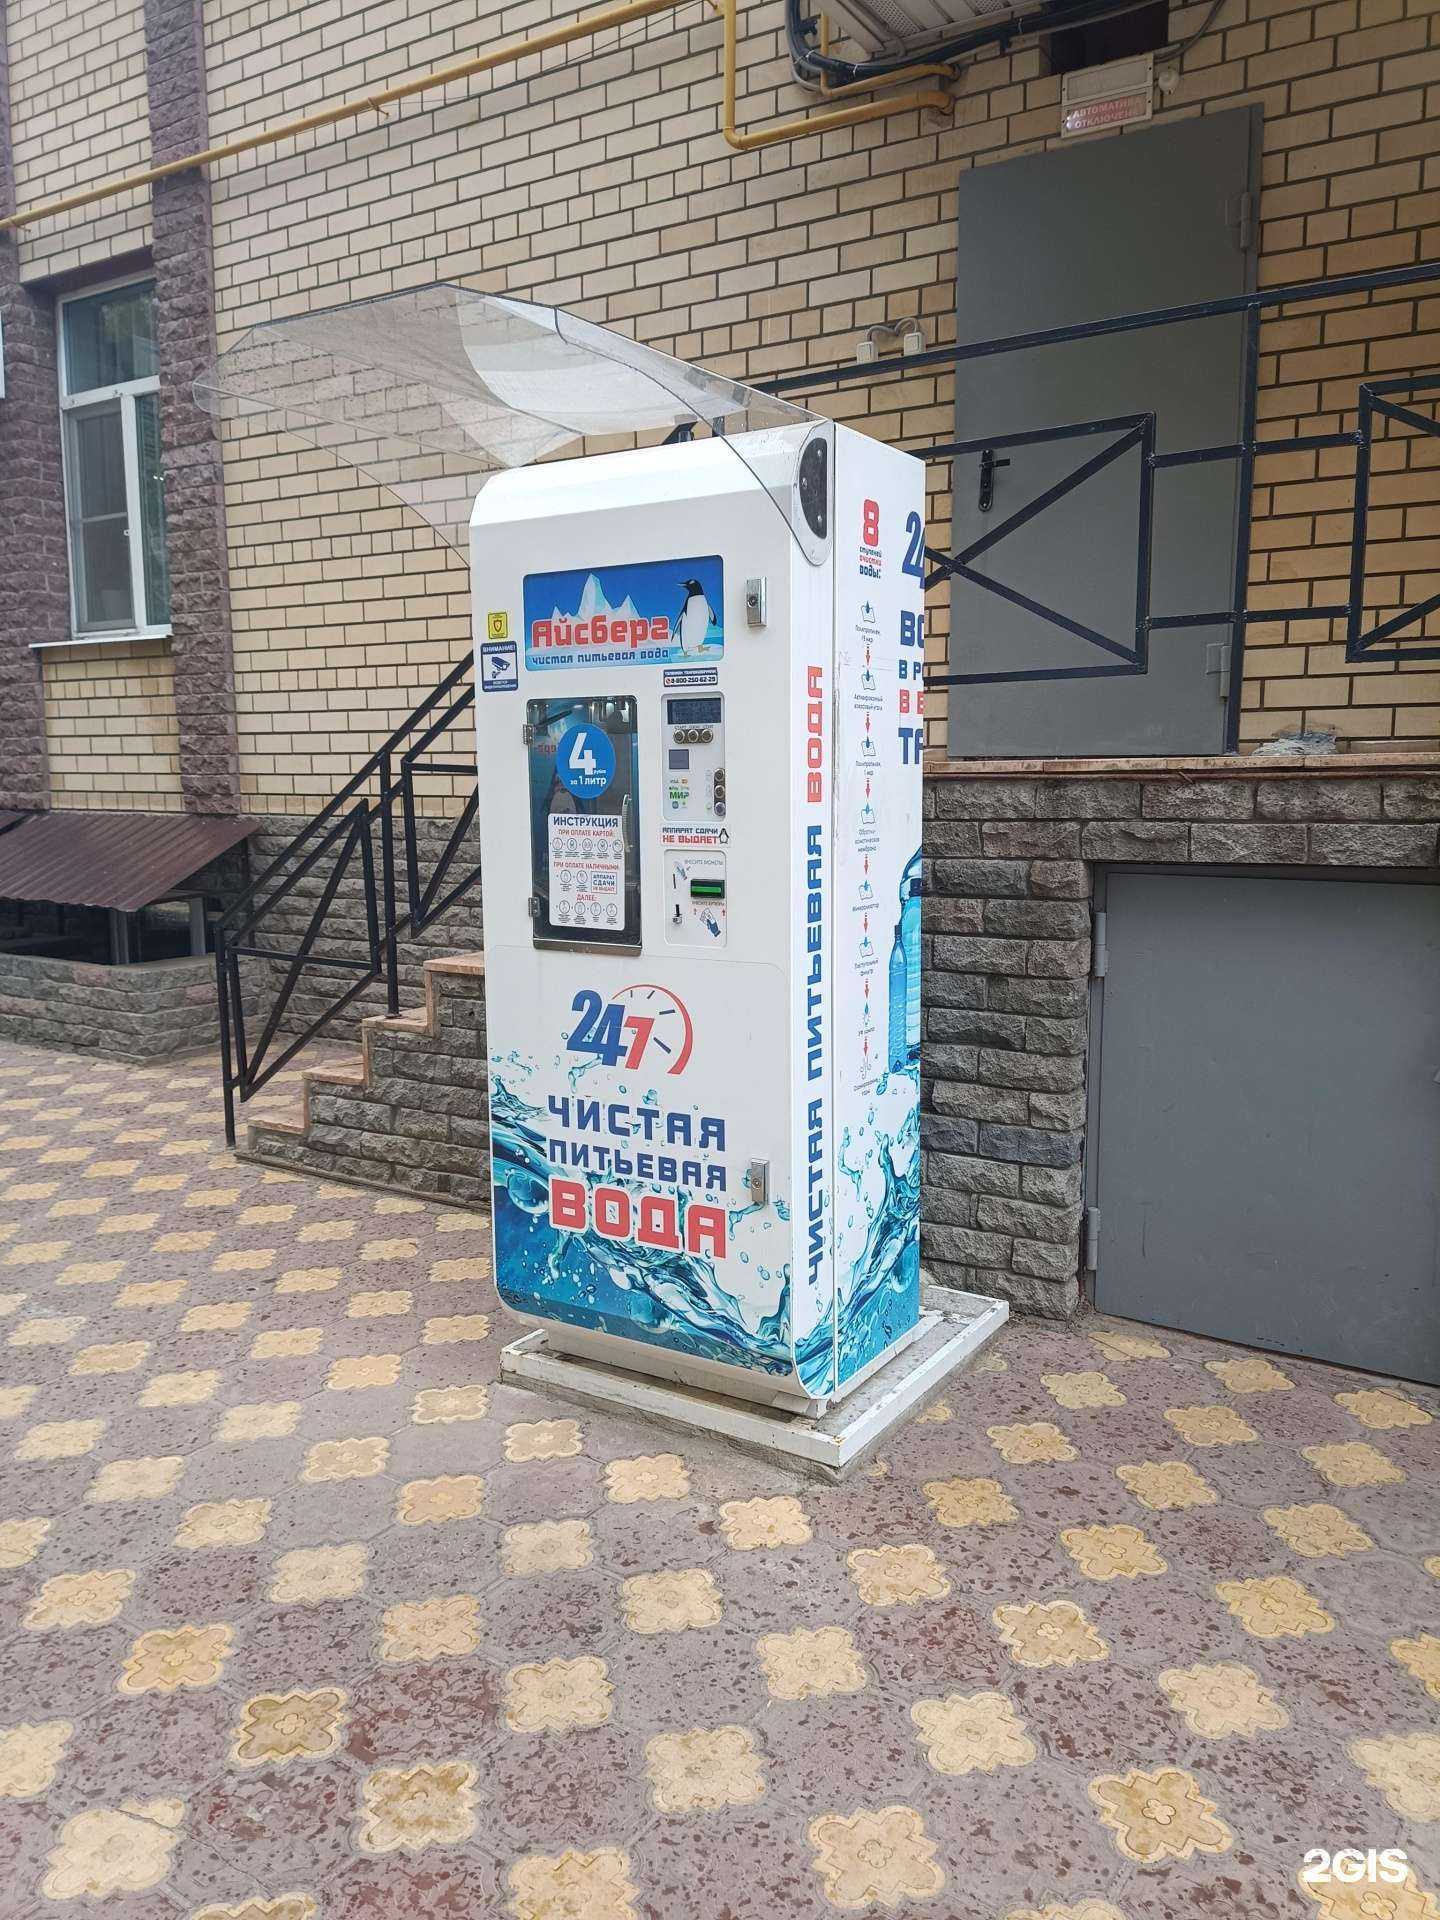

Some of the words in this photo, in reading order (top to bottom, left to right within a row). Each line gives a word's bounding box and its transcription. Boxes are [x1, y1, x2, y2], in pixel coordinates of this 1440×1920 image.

[863, 499, 879, 546] 8
[533, 615, 669, 648] Айсберг
[532, 654, 573, 666] чистая
[577, 652, 635, 663] питьевая
[640, 648, 669, 659] вода
[899, 660, 907, 679] В
[913, 662, 924, 680] Р
[900, 689, 910, 713] В
[807, 666, 823, 802] ВОДА
[569, 732, 597, 775] 4
[578, 776, 583, 785] 1
[584, 777, 607, 787] литр
[669, 791, 690, 800] МИР
[553, 816, 619, 829] ИНСТРУКЦИЯ
[662, 835, 675, 843] НЕ
[678, 835, 718, 844] ВЫДАЕТ
[807, 825, 822, 1081] ПИТЬЕВАЯ
[548, 1095, 726, 1152] ЧИСТАЯ
[549, 1138, 727, 1192] ПИТЬЕВАЯ
[808, 1098, 823, 1285] ЧИСТАЯ
[551, 1177, 727, 1259] ВОДА
